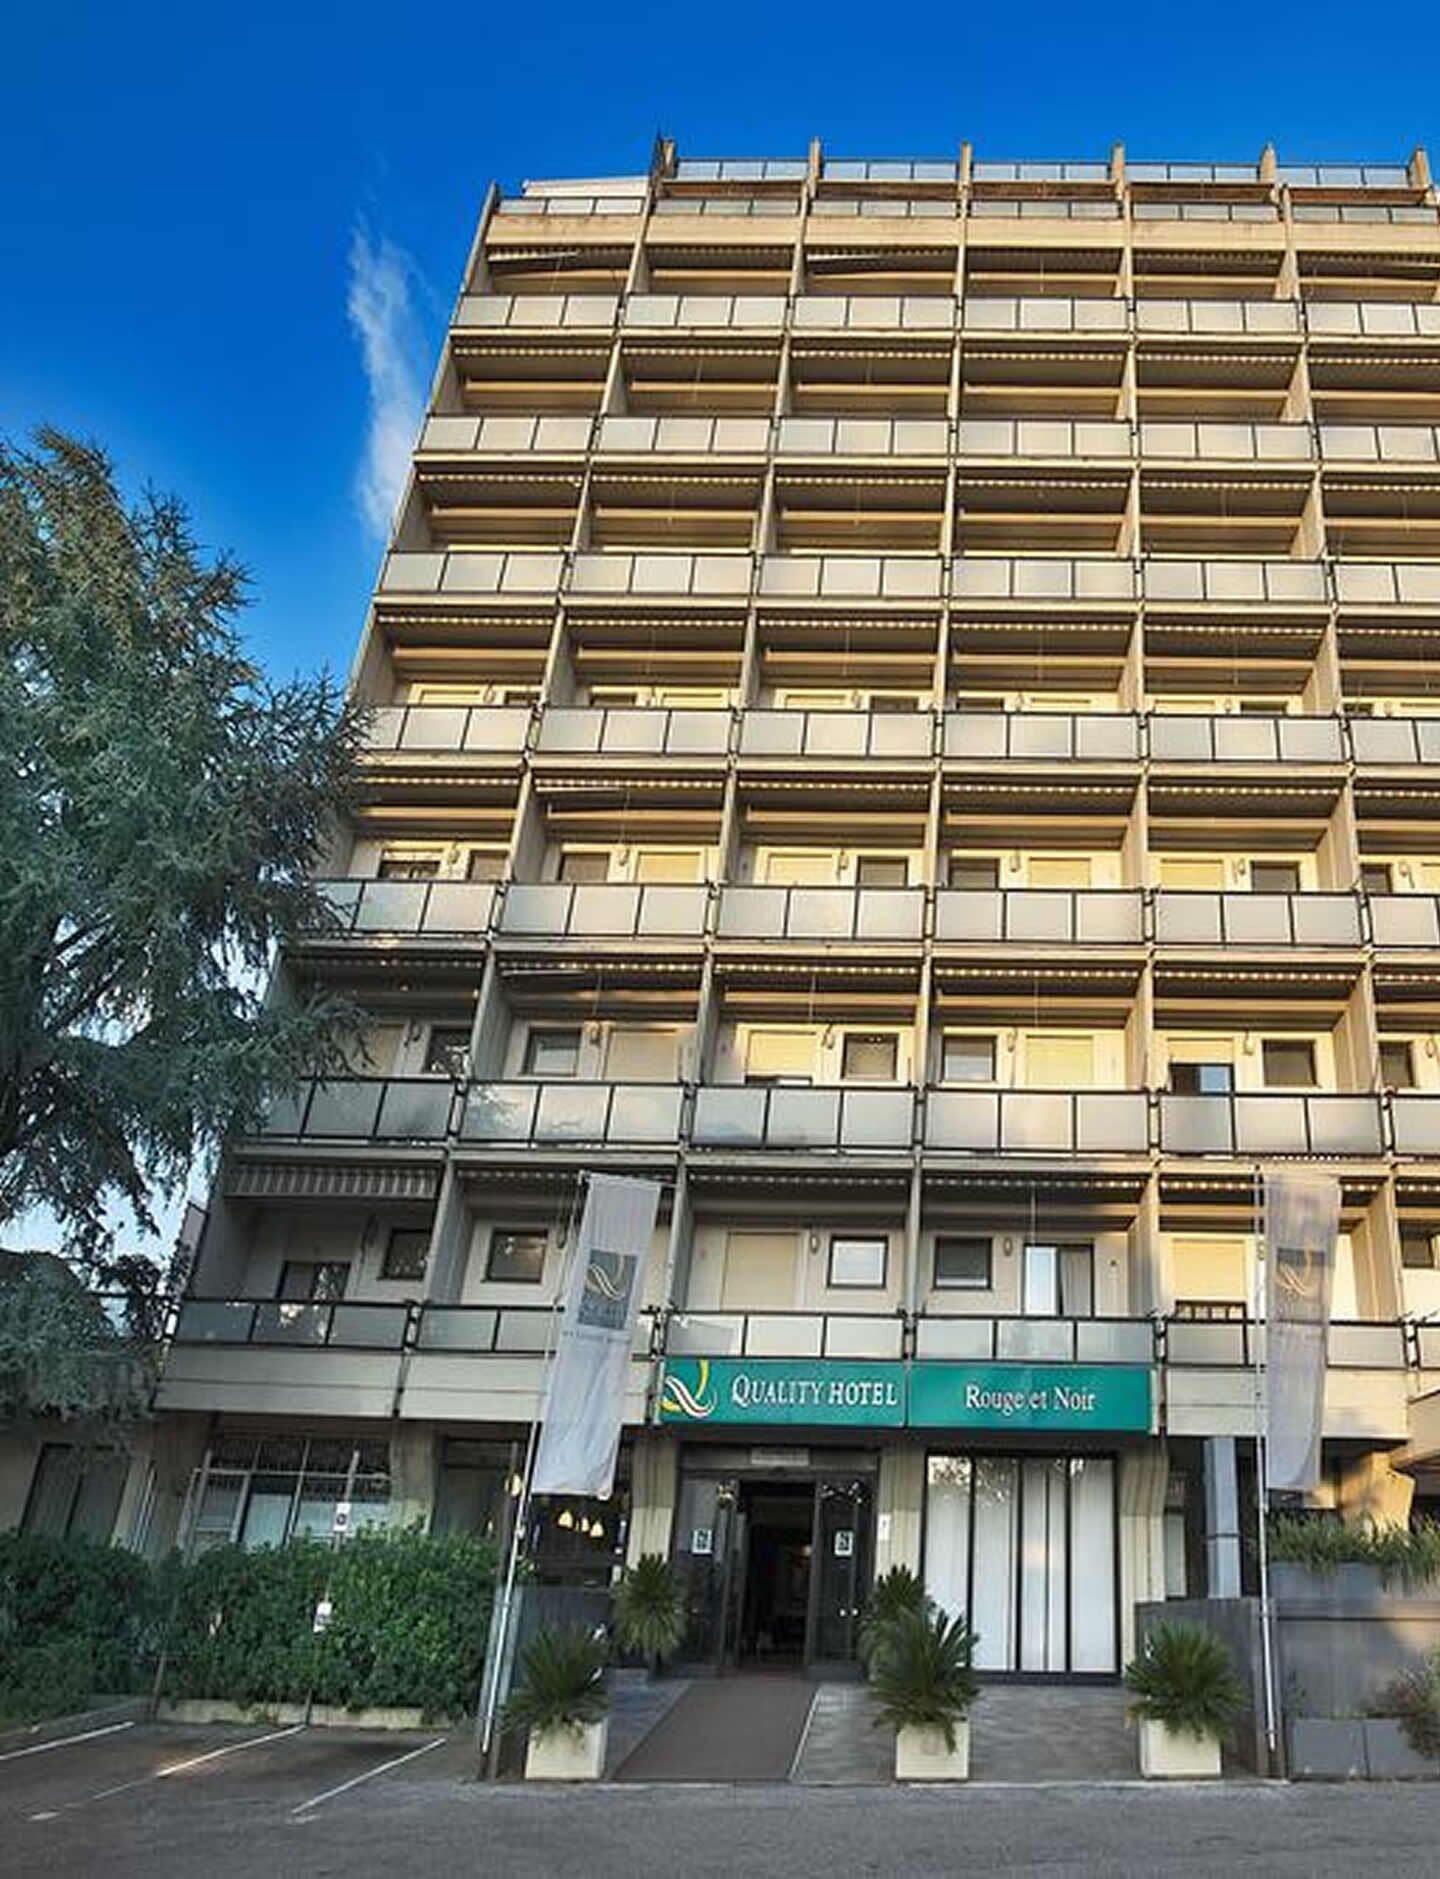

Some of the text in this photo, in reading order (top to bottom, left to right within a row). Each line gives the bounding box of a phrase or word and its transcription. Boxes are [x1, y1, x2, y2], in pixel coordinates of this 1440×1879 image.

[731, 1373, 898, 1408] QUALITY HOTEL
[966, 1384, 1096, 1417] Rouge et Noir
